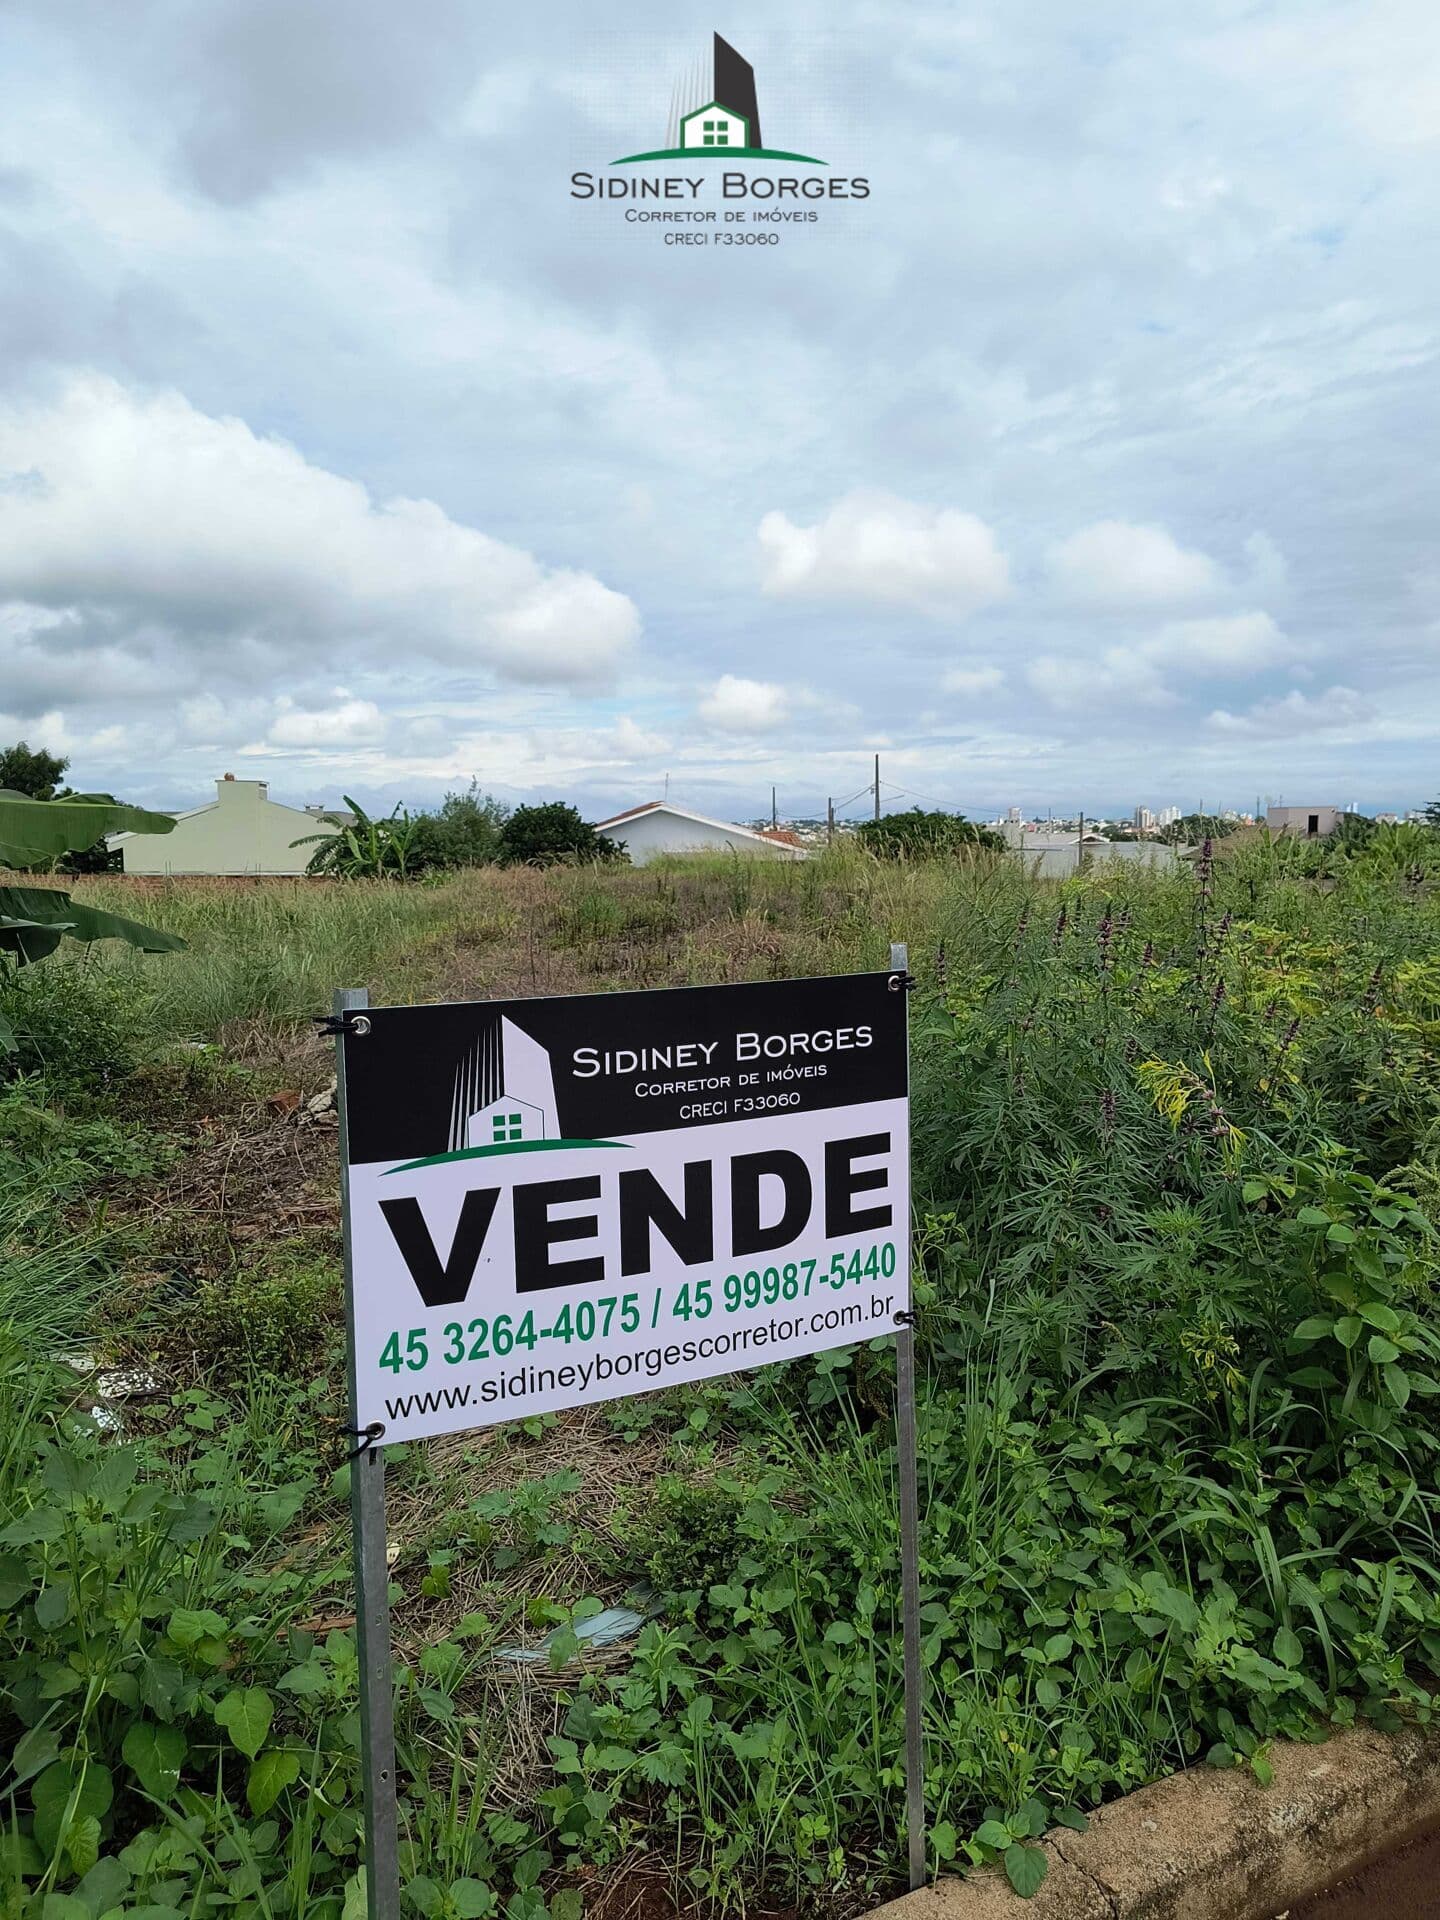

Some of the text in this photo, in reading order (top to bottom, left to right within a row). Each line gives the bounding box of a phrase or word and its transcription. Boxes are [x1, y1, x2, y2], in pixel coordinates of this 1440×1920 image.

[572, 1026, 873, 1078] SIDINEY BORGES
[634, 1064, 828, 1098] CORRETOR DE IMÓVEIS
[679, 1092, 801, 1120] CRECI F33060
[378, 1132, 893, 1308] VENDE
[379, 1242, 897, 1374] 45 3264-4075 / 45 99987-5440
[385, 1292, 895, 1421] www.sidineyborgescorretor.com.br
